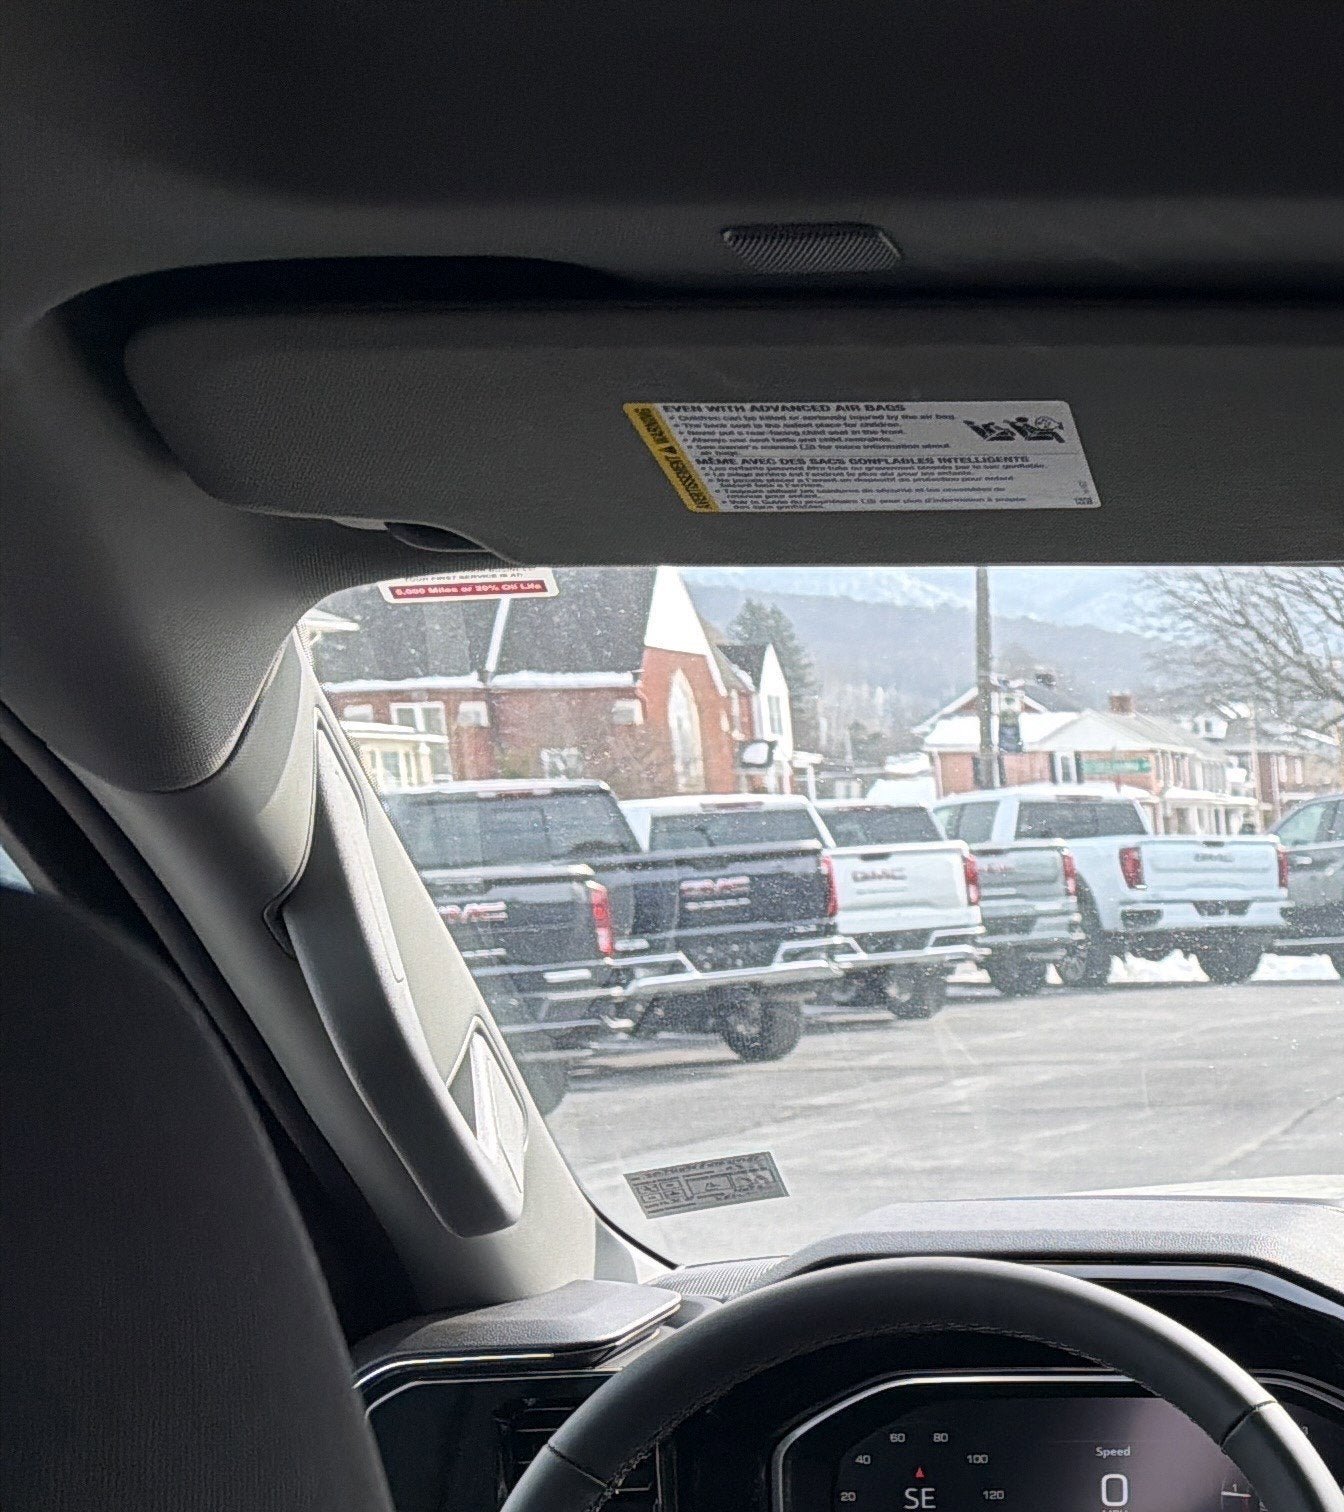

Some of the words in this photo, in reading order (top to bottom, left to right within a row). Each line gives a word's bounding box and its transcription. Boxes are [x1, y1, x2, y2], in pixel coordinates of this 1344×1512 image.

[663, 404, 702, 412] EVEN
[835, 404, 861, 412] AIR
[864, 404, 906, 412] BAGS
[428, 586, 459, 594] Miles
[890, 1433, 906, 1443] 60
[933, 1433, 948, 1443] 80
[1095, 1446, 1131, 1459] Speed
[855, 1455, 871, 1465] 40
[966, 1454, 989, 1464] 100
[983, 1490, 1005, 1500] 120
[1101, 1473, 1129, 1507] 0
[841, 1492, 857, 1502] 20
[903, 1487, 937, 1510] SE
